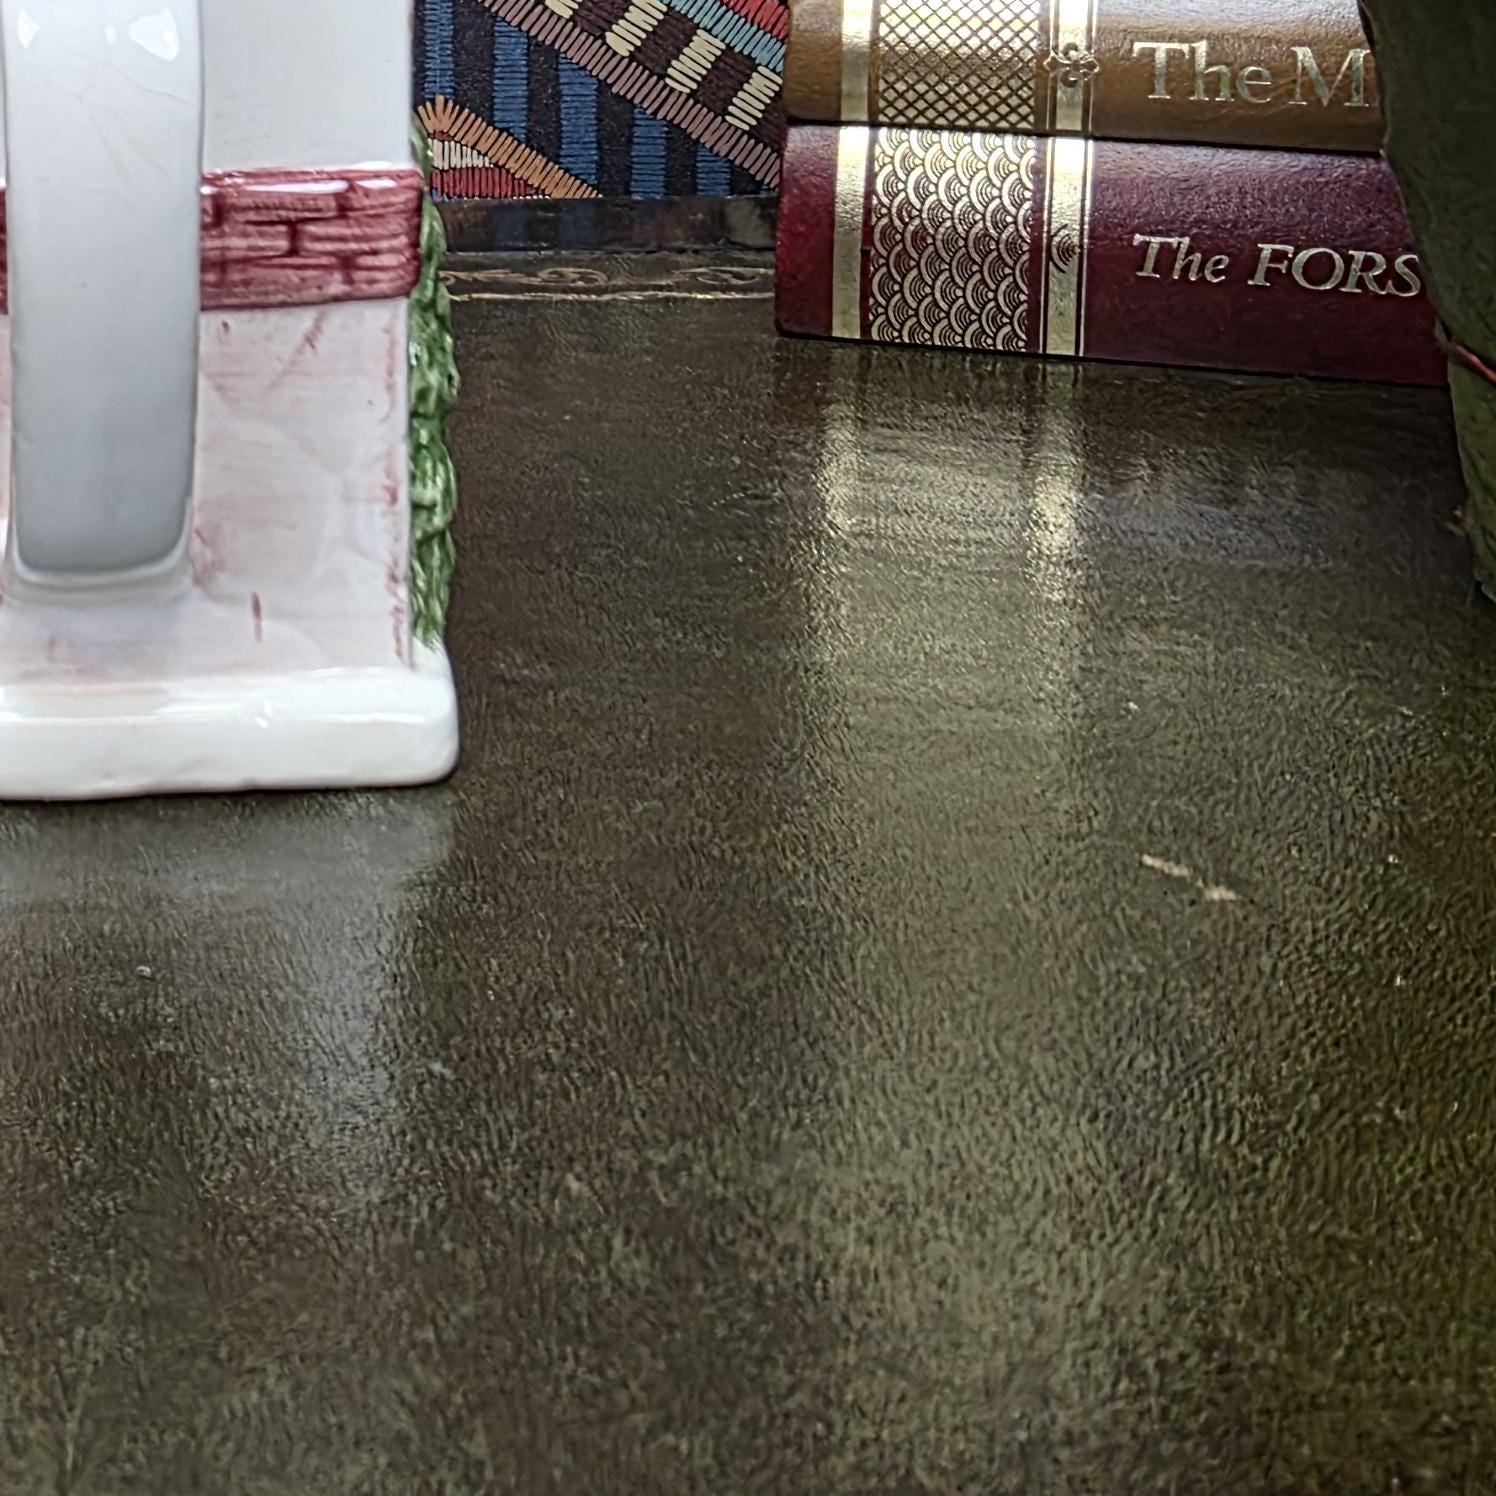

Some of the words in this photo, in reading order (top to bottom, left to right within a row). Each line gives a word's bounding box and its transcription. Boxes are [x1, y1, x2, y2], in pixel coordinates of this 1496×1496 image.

[1132, 40, 1272, 104] The
[1288, 45, 1372, 107] M
[1132, 233, 1230, 283] The
[1247, 243, 1422, 297] FORS
